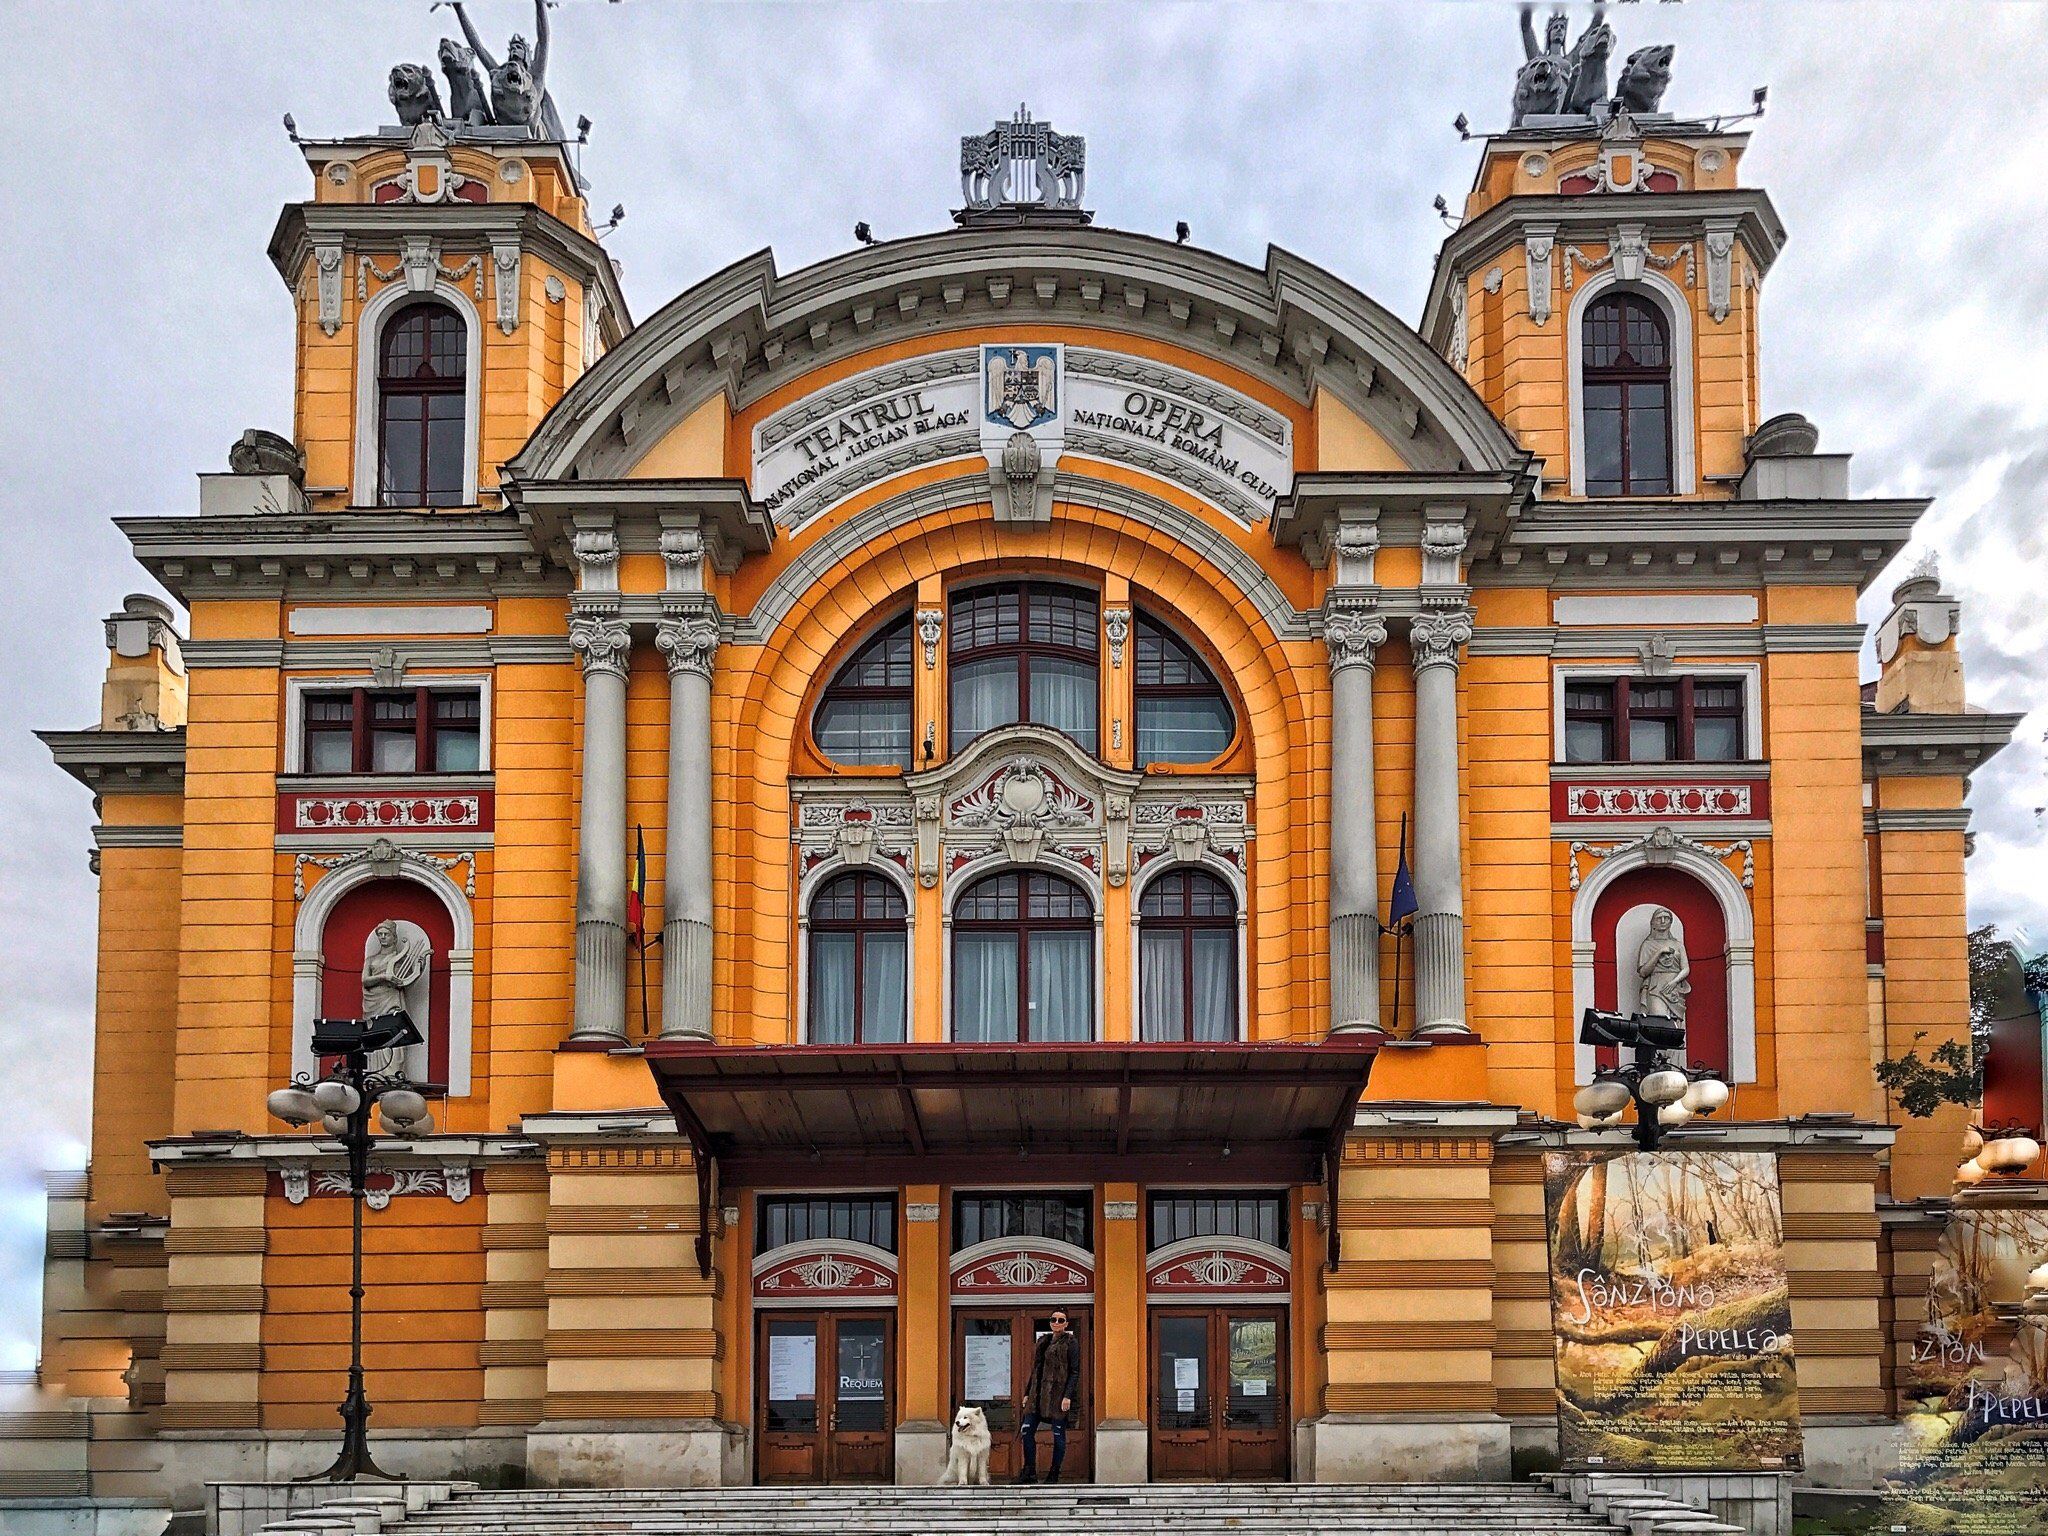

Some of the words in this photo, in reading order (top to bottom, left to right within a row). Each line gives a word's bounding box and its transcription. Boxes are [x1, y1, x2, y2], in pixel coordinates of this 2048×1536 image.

[794, 392, 935, 462] TEATRUL
[1124, 392, 1223, 448] OPERA
[1073, 409, 1167, 443] NAȚIONALĂ
[1171, 434, 1239, 477] ROMÂNĂ
[1240, 470, 1279, 500] CLUJ
[840, 1376, 883, 1389] REQUIEM
